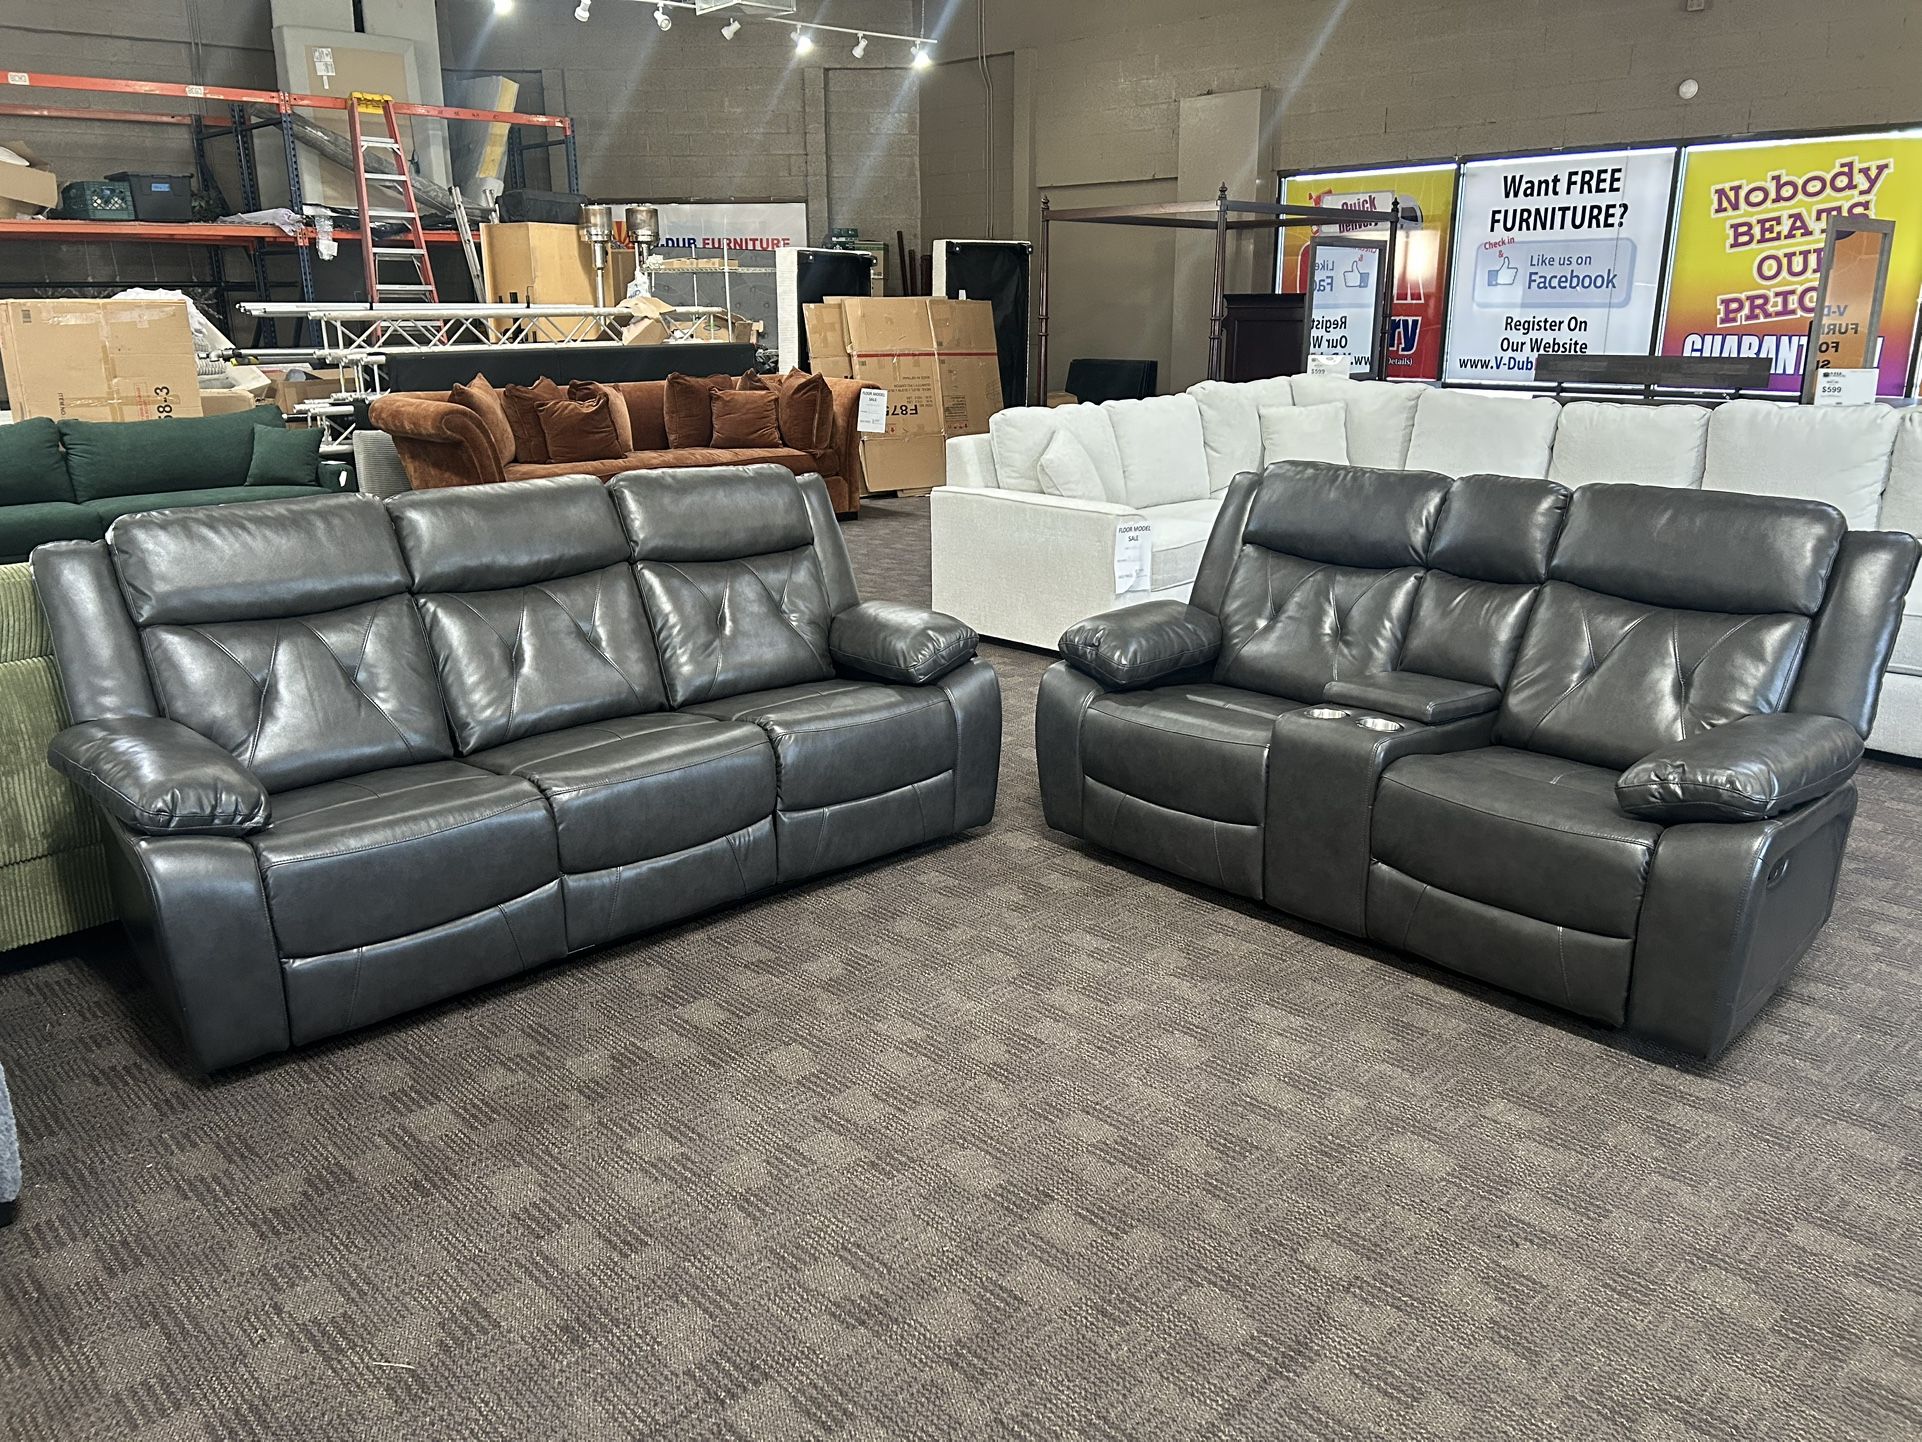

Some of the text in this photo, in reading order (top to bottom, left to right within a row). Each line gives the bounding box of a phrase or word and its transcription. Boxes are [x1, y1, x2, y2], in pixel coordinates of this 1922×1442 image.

[1503, 167, 1623, 199] Want FREE
[1713, 160, 1889, 214] Nobody
[1489, 202, 1629, 233] FURNITURE?
[655, 237, 790, 250] -DUB FURNITURE
[1484, 236, 1515, 250] Check in
[1498, 250, 1505, 258] &
[1530, 254, 1592, 267] Like us on
[1527, 269, 1617, 290] Facebook
[1504, 316, 1588, 335] Register On
[1500, 337, 1588, 354] Our Website
[1459, 356, 1538, 371] www.V-Dub
[1119, 526, 1132, 534] FLOOR
